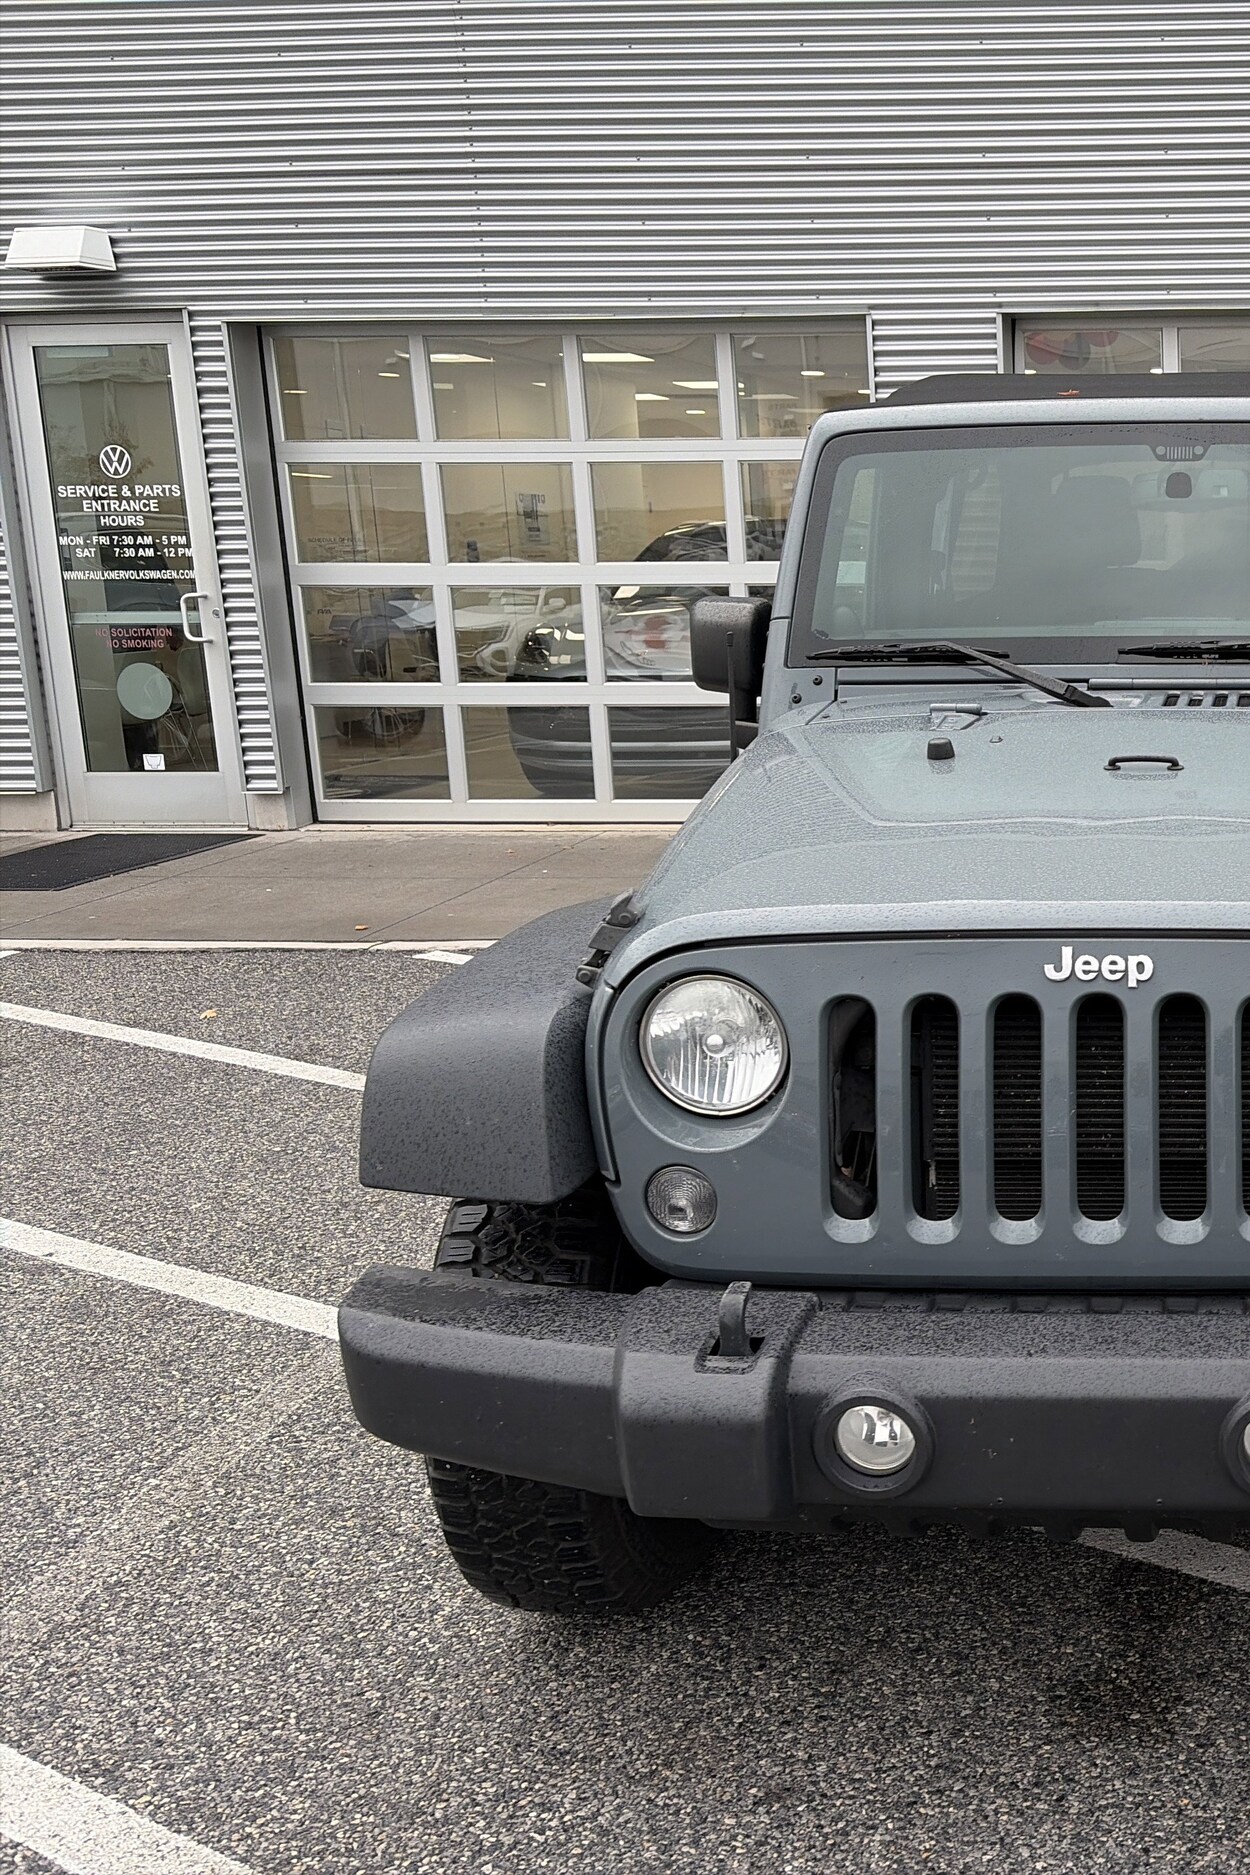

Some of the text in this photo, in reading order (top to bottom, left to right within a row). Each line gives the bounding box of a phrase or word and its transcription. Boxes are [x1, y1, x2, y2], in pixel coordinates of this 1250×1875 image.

[57, 484, 181, 498] SERVICE & PARTS
[82, 499, 160, 512] ENTRANCE
[100, 515, 145, 527] HOURS
[59, 536, 84, 546] MON
[92, 535, 110, 545] FRI
[112, 535, 134, 545] 7:30
[136, 535, 153, 545] AM
[162, 535, 169, 545] 5
[170, 535, 187, 545] PM
[75, 547, 97, 558] SAT
[114, 547, 136, 558] 7:30
[137, 547, 155, 557] AM
[163, 547, 176, 557] 12
[177, 547, 193, 557] PM
[63, 570, 196, 580] WWW.FAULKNERVOLKSWAGEN.COM
[95, 628, 173, 637] NO SOLICITATION
[106, 639, 165, 648] NO SMOKING
[1044, 946, 1154, 988] Jeep
